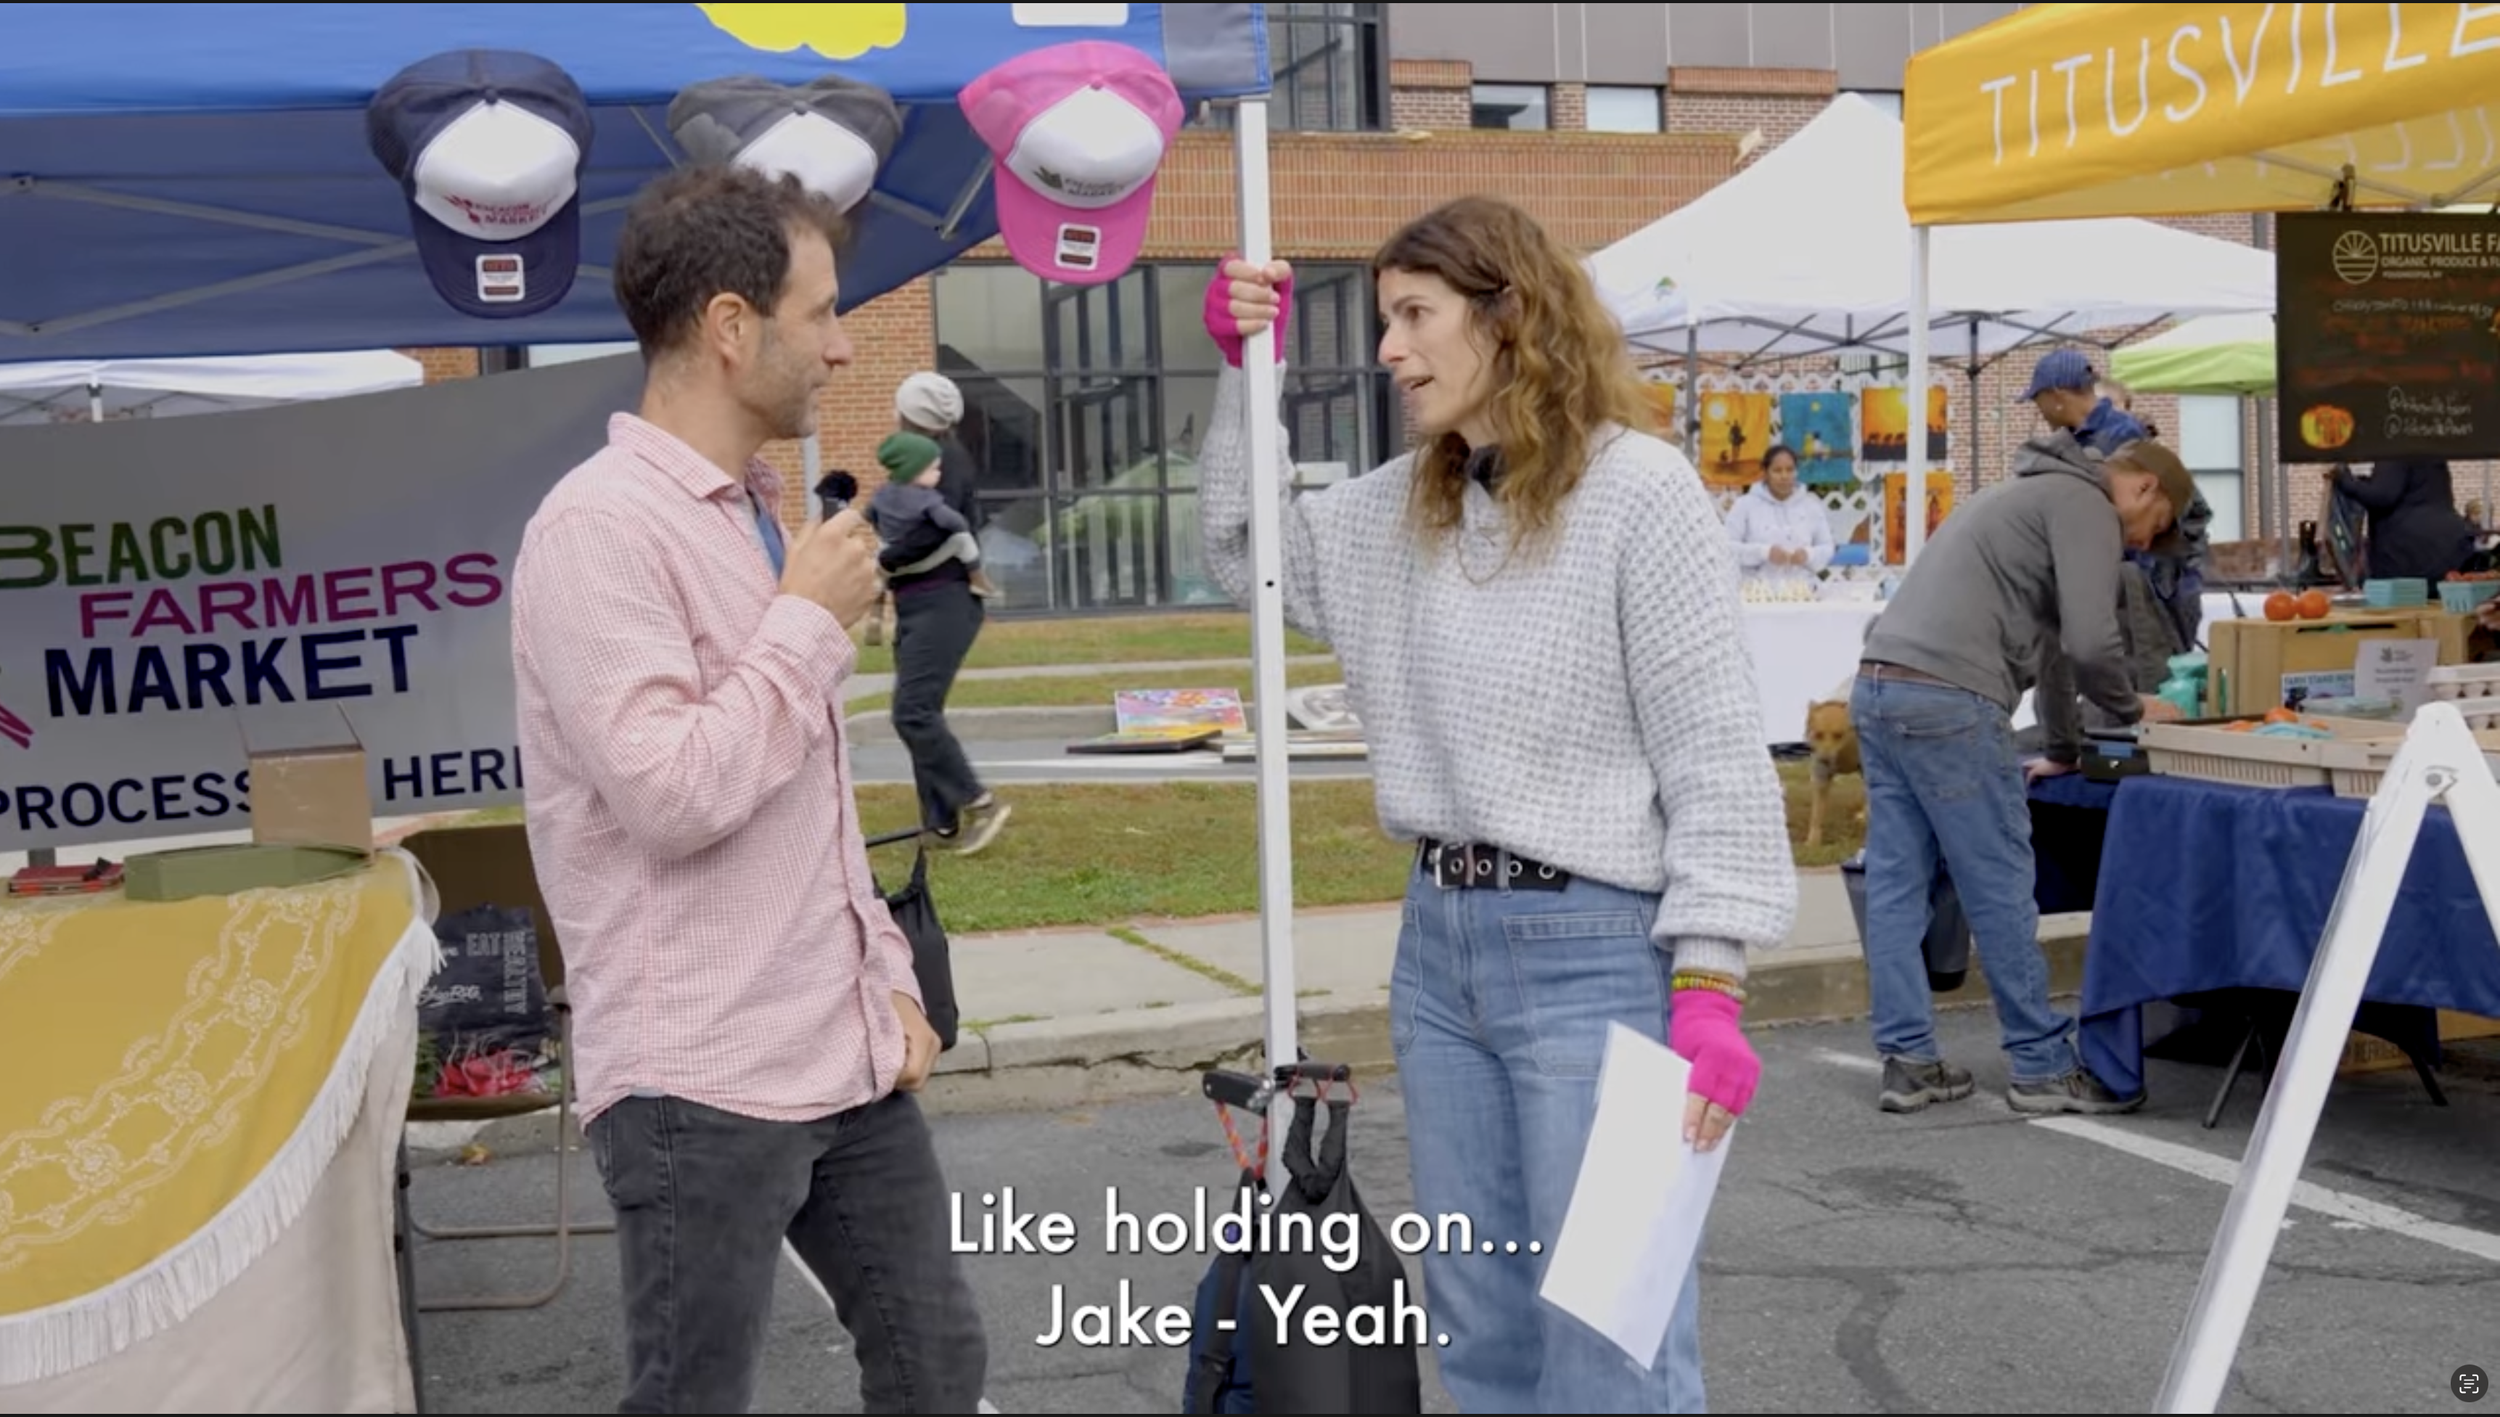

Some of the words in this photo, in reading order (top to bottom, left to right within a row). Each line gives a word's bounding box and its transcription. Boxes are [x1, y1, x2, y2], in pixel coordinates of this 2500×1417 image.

[1980, 3, 2500, 166] TITUSVILLE
[2378, 232, 2482, 253] TITUSVILLE
[2380, 255, 2428, 268] ORGANIC
[2430, 255, 2478, 268] PRODUCE
[0, 504, 282, 589] BEACON
[80, 553, 502, 638] FARMERS
[45, 625, 418, 717] MARKET
[466, 933, 500, 957] EAT
